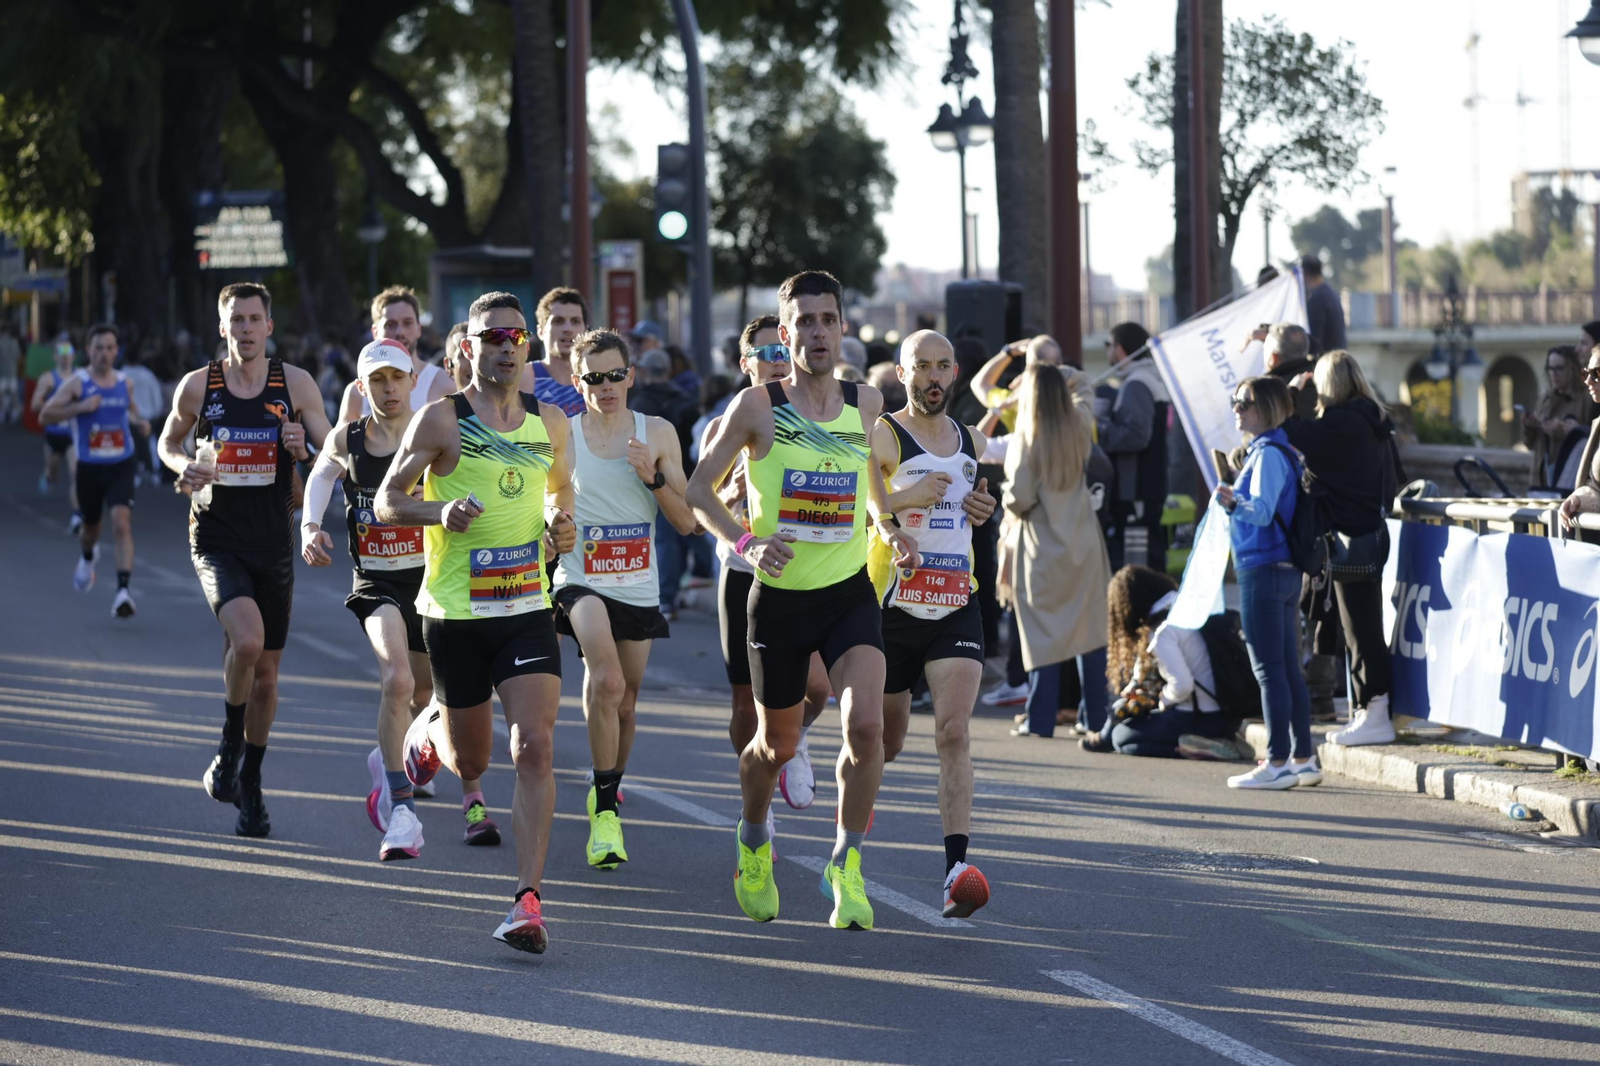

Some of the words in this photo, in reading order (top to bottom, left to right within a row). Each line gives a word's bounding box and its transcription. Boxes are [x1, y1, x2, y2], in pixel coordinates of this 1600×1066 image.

[234, 431, 270, 440] ZURICH
[236, 449, 252, 457] 630
[216, 463, 236, 472] VERT
[238, 463, 276, 472] FEYAERTS
[810, 476, 850, 487] ZURICH
[812, 497, 830, 507] 473
[797, 508, 838, 525] DIEGO
[380, 532, 397, 541] 709
[607, 527, 644, 537] ZURICH
[367, 540, 417, 556] CLAUDE
[611, 546, 627, 556] 728
[497, 546, 532, 561] ZURICH
[592, 556, 644, 572] NICOLAS
[927, 556, 962, 567] ZURICH
[501, 571, 517, 581] 475
[925, 575, 946, 586] 1148
[493, 581, 522, 599] IVÁN
[896, 588, 922, 603] LUIS
[925, 591, 969, 607] SANTOS
[962, 641, 981, 650] TERREX
